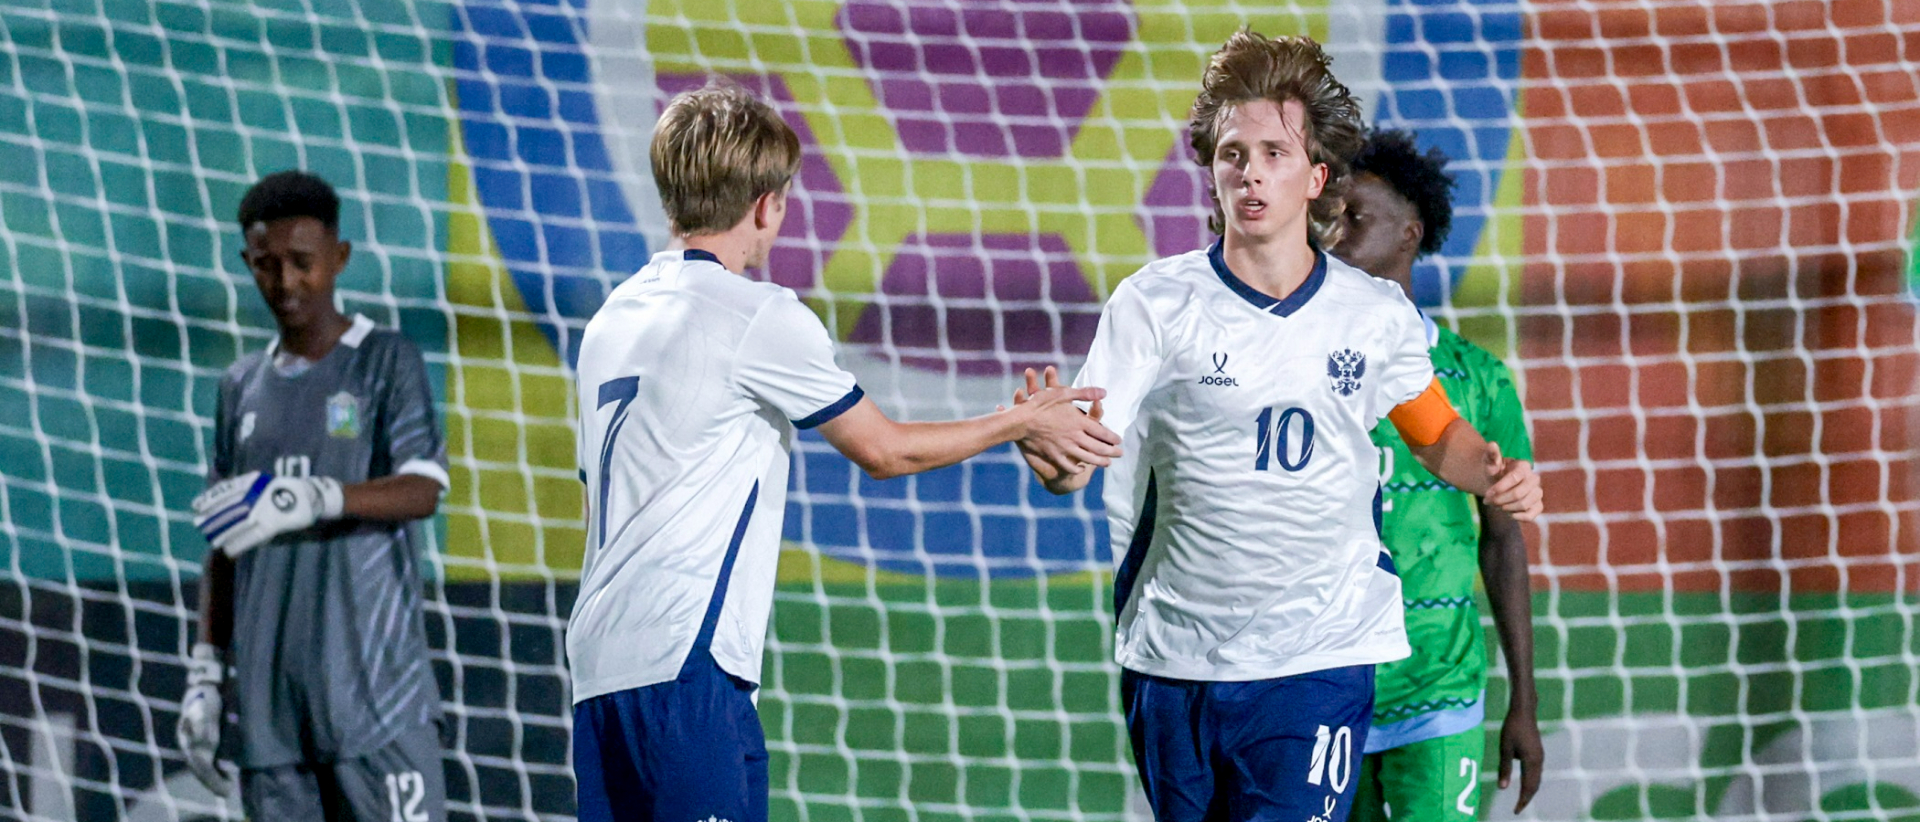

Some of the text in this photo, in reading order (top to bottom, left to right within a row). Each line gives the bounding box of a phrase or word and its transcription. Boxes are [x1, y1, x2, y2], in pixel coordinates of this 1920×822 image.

[1198, 375, 1239, 387] JOGEL
[597, 375, 640, 550] 7
[1255, 406, 1315, 472] 10
[1307, 724, 1351, 794] 10
[1457, 757, 1477, 816] 2
[386, 770, 429, 822] 12
